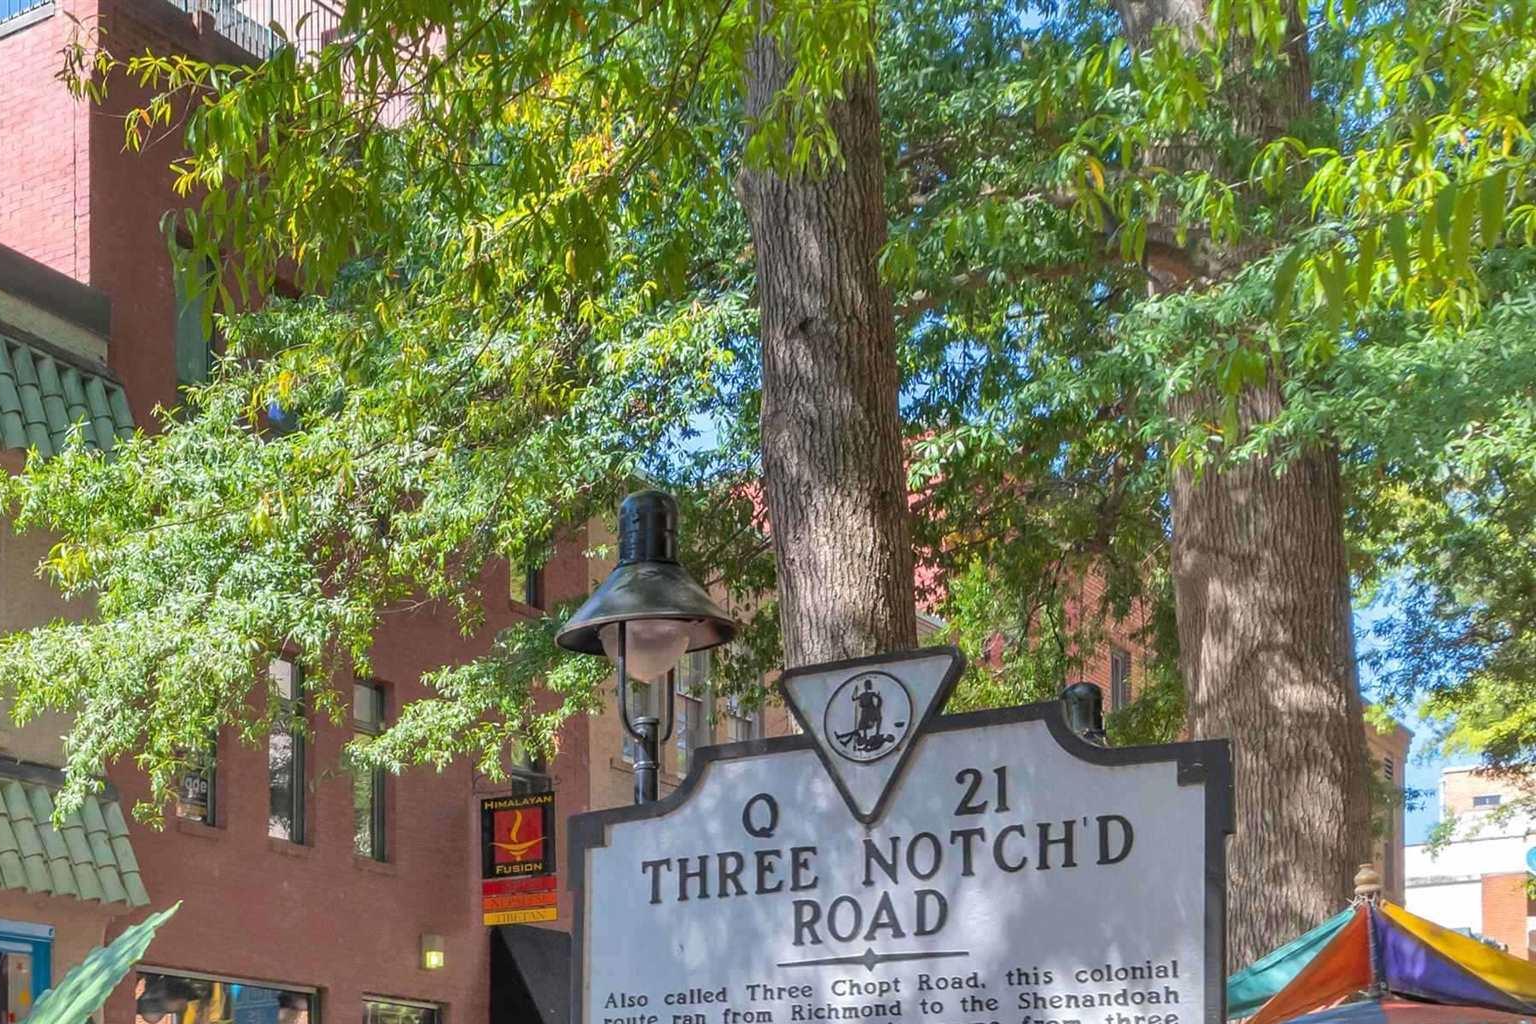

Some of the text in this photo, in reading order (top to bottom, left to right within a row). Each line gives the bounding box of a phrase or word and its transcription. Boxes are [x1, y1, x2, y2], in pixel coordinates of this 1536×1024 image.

[484, 795, 552, 809] HIMALAYAN
[743, 766, 1010, 837] Q 21
[496, 863, 543, 875] FUSION
[642, 814, 1135, 904] THREE NOTCH'D
[793, 889, 949, 945] ROAD
[605, 993, 648, 1009] Also
[664, 987, 728, 1005] called
[746, 984, 812, 1001] Three
[831, 977, 900, 997] Chopt
[1006, 967, 1053, 986] this
[1075, 960, 1178, 983] colonial
[723, 1008, 773, 1024] from
[791, 1001, 902, 1021] Richmond
[920, 999, 943, 1014] to
[960, 996, 998, 1012] the
[1018, 987, 1179, 1009] Shenandoah
